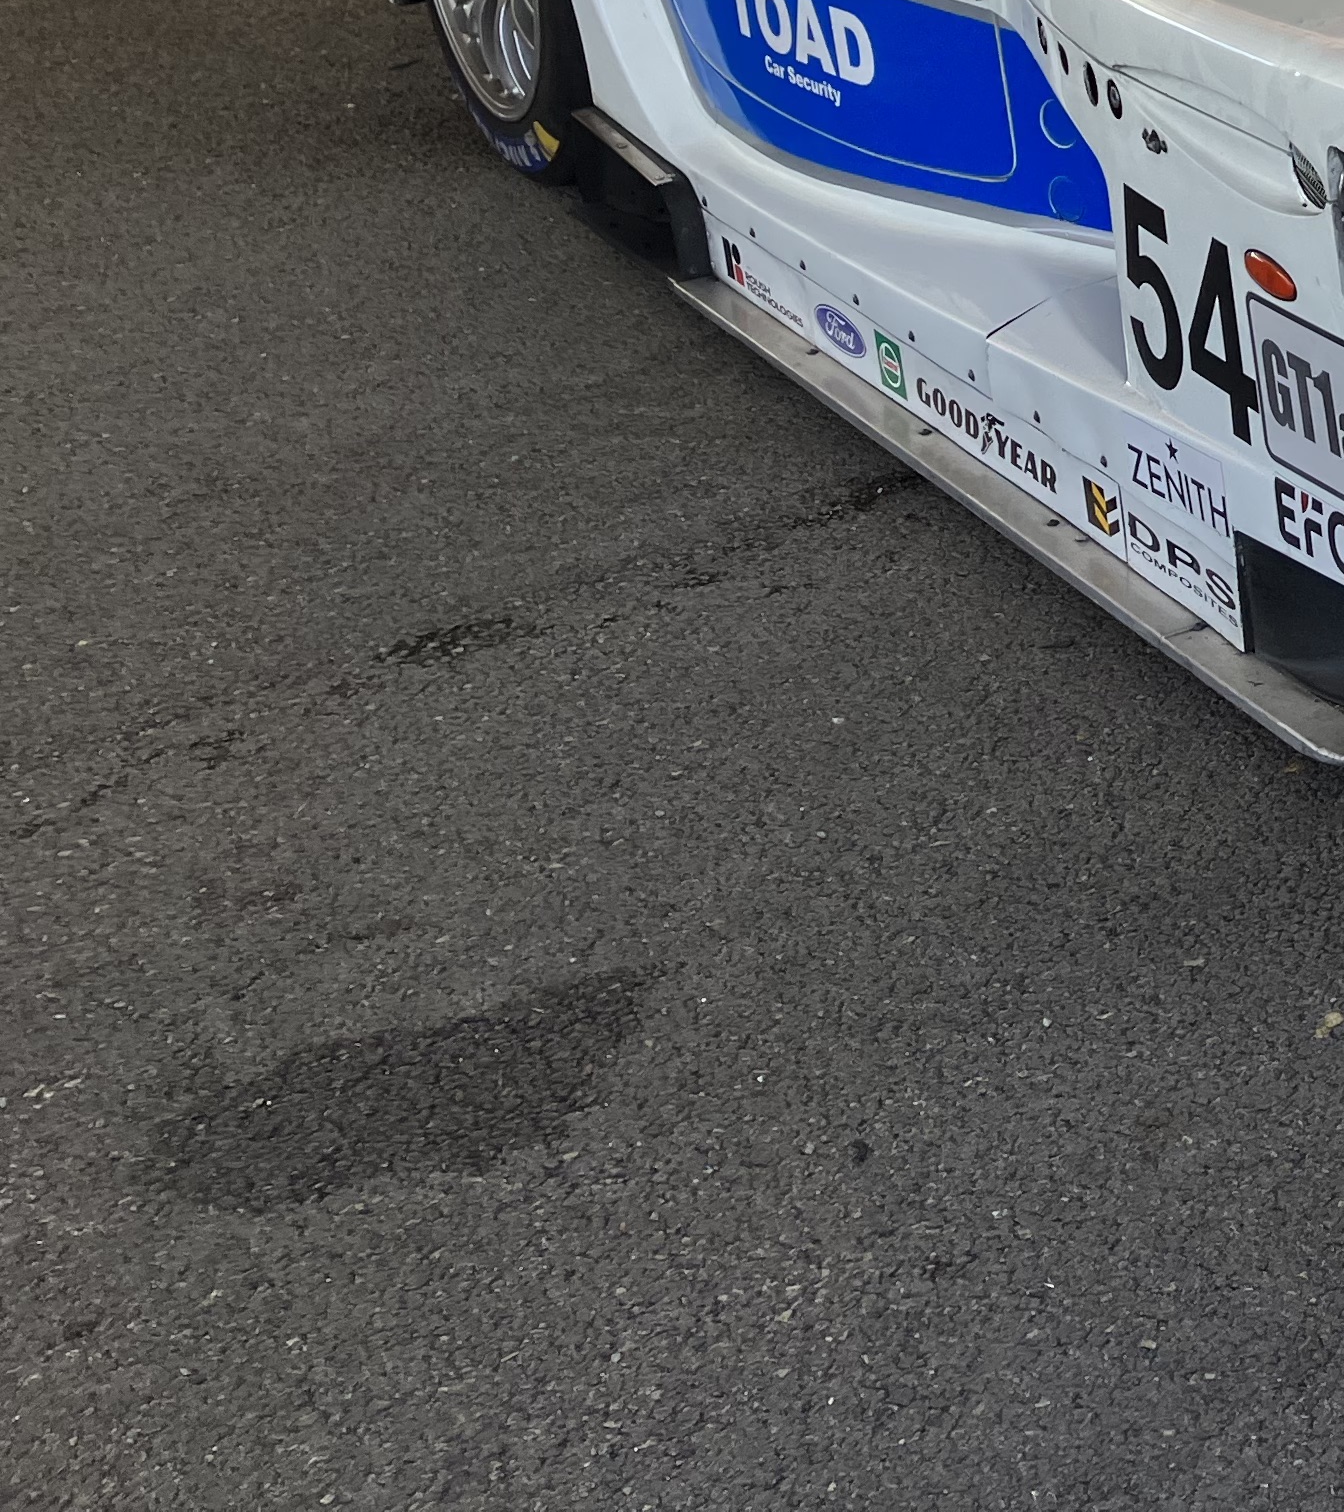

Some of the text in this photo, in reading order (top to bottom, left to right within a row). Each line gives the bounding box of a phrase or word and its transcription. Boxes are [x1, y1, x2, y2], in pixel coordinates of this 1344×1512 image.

[764, 54, 841, 106] Car Security
[824, 310, 856, 351] Ford
[1123, 182, 1259, 446] 54
[1127, 442, 1231, 538] ZENITH
[1128, 511, 1236, 610] DPS
[1130, 541, 1239, 628] COMPOSITES
